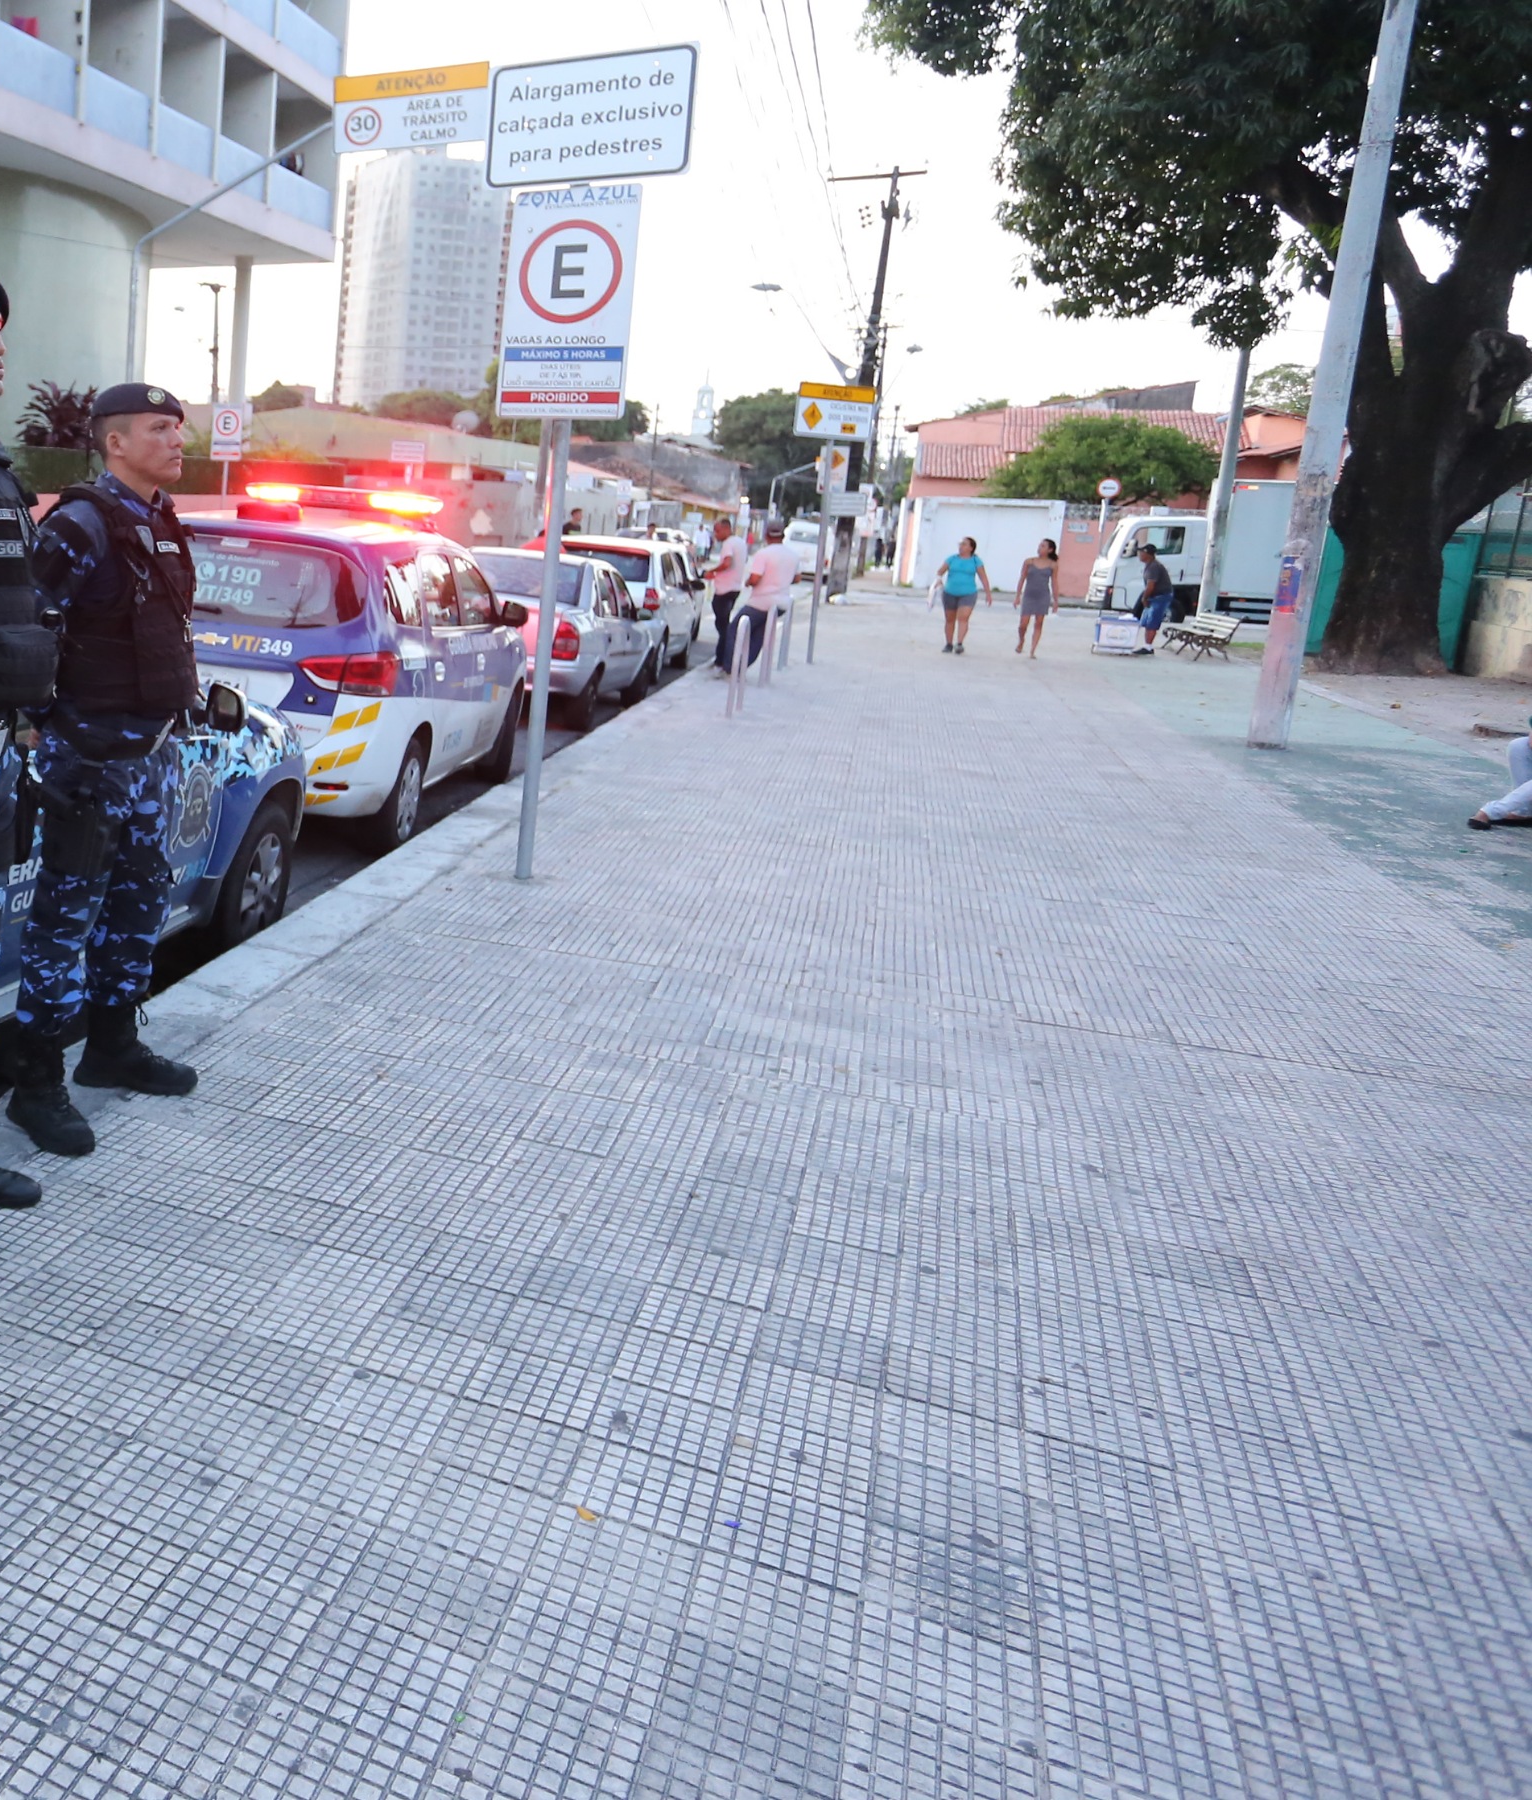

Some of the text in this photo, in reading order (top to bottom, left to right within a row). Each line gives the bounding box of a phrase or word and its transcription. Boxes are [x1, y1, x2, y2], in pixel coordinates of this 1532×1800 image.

[375, 72, 446, 92] ATENÇÃO
[509, 70, 674, 102] Alargamento de
[446, 95, 463, 107] DE
[350, 114, 376, 132] 30
[402, 110, 467, 127] TRÂNSITO
[498, 102, 683, 134] calçada exclusivo
[410, 127, 457, 141] CALMO
[509, 137, 662, 167] para pedestres
[518, 184, 638, 208] ZONA AZUL
[550, 244, 588, 299] E
[506, 336, 606, 344] VAGAS AO LONGO
[521, 349, 560, 359] MÁXIMO
[571, 350, 606, 359] HORAS
[530, 392, 589, 402] PROIBIDO
[223, 416, 232, 430] E
[217, 565, 262, 586] 190
[195, 584, 254, 605] VT/349
[231, 634, 293, 656] VT/349
